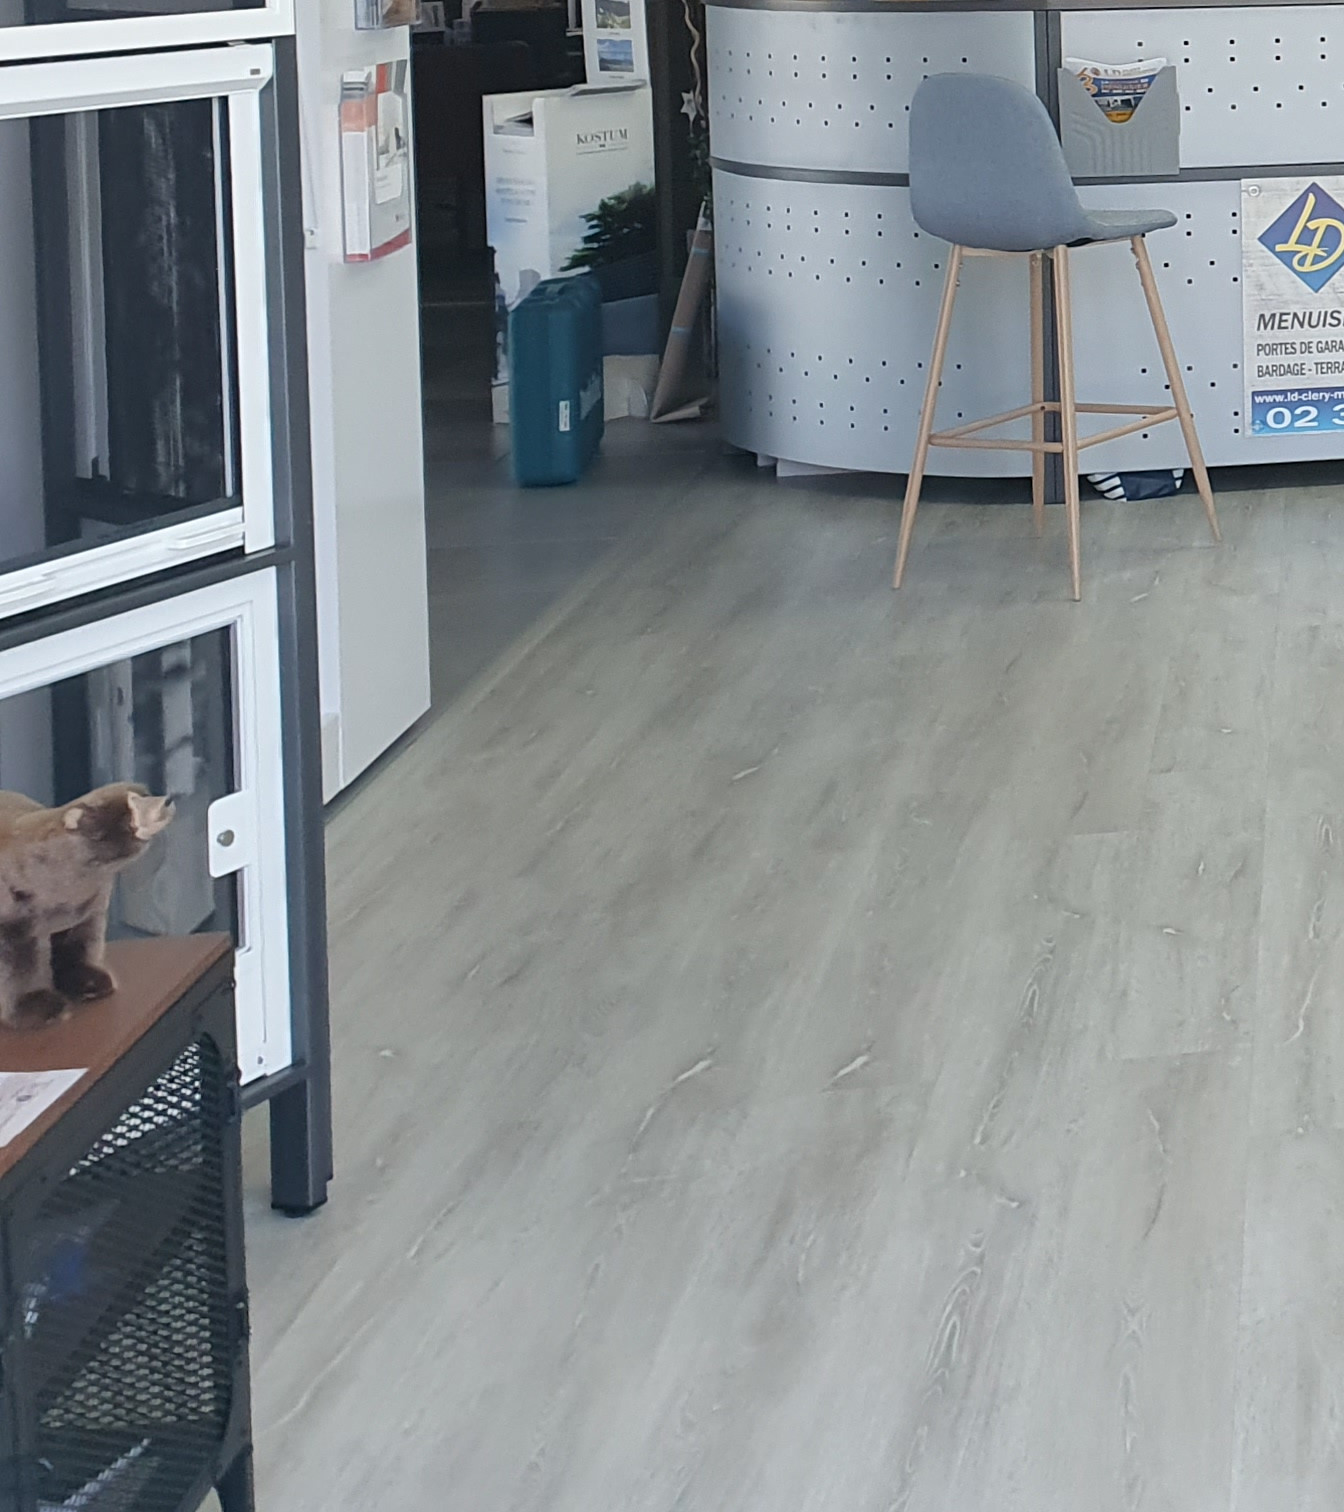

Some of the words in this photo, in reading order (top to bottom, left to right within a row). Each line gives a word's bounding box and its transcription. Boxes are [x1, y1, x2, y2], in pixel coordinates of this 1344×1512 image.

[576, 129, 628, 145] KOSTUM
[1256, 342, 1297, 357] PORTES
[1300, 341, 1314, 355] DE
[1257, 362, 1307, 378] BARDAGE
[1266, 405, 1319, 429] 02
